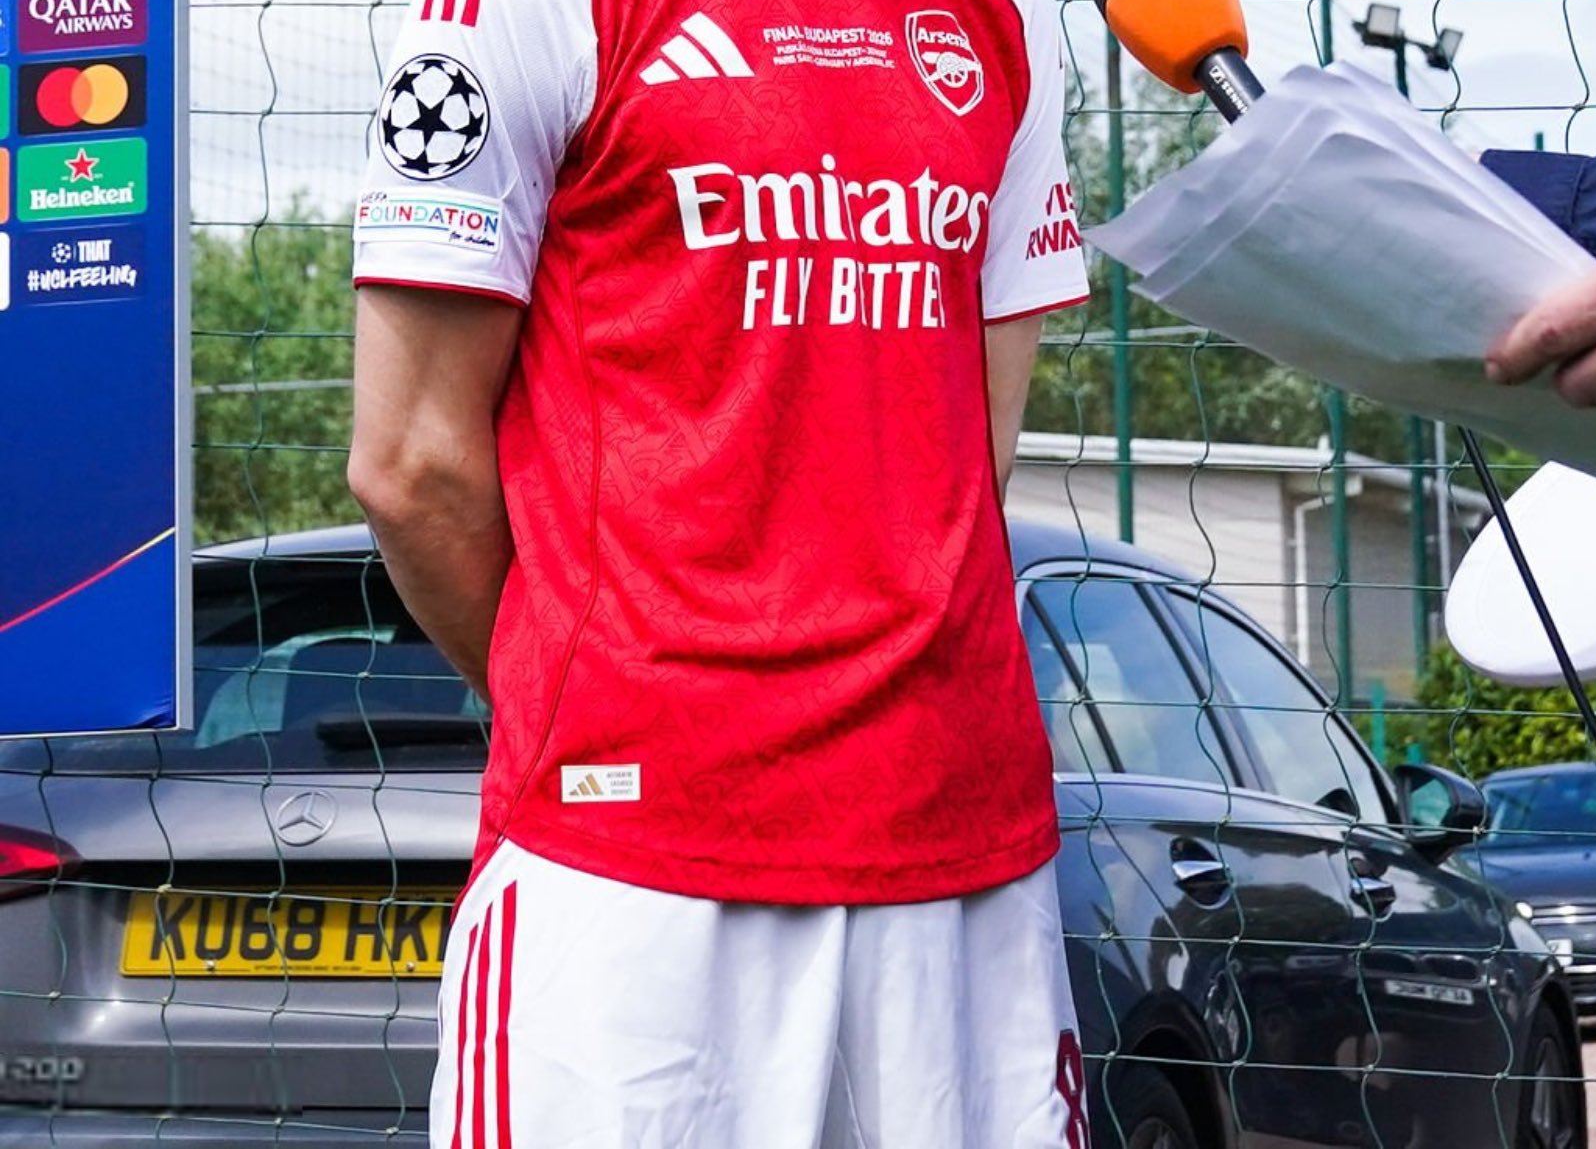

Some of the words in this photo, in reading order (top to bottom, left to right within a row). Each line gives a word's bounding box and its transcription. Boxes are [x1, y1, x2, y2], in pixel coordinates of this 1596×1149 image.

[54, 13, 134, 35] AIRWAYS
[763, 25, 804, 43] FINAL
[917, 26, 971, 50] Arsen
[30, 185, 134, 210] Heineken
[666, 153, 989, 253] Emirates
[77, 239, 112, 263] THAT
[742, 257, 814, 330] FLY
[829, 256, 945, 330] BTTE
[150, 896, 326, 961] KU68
